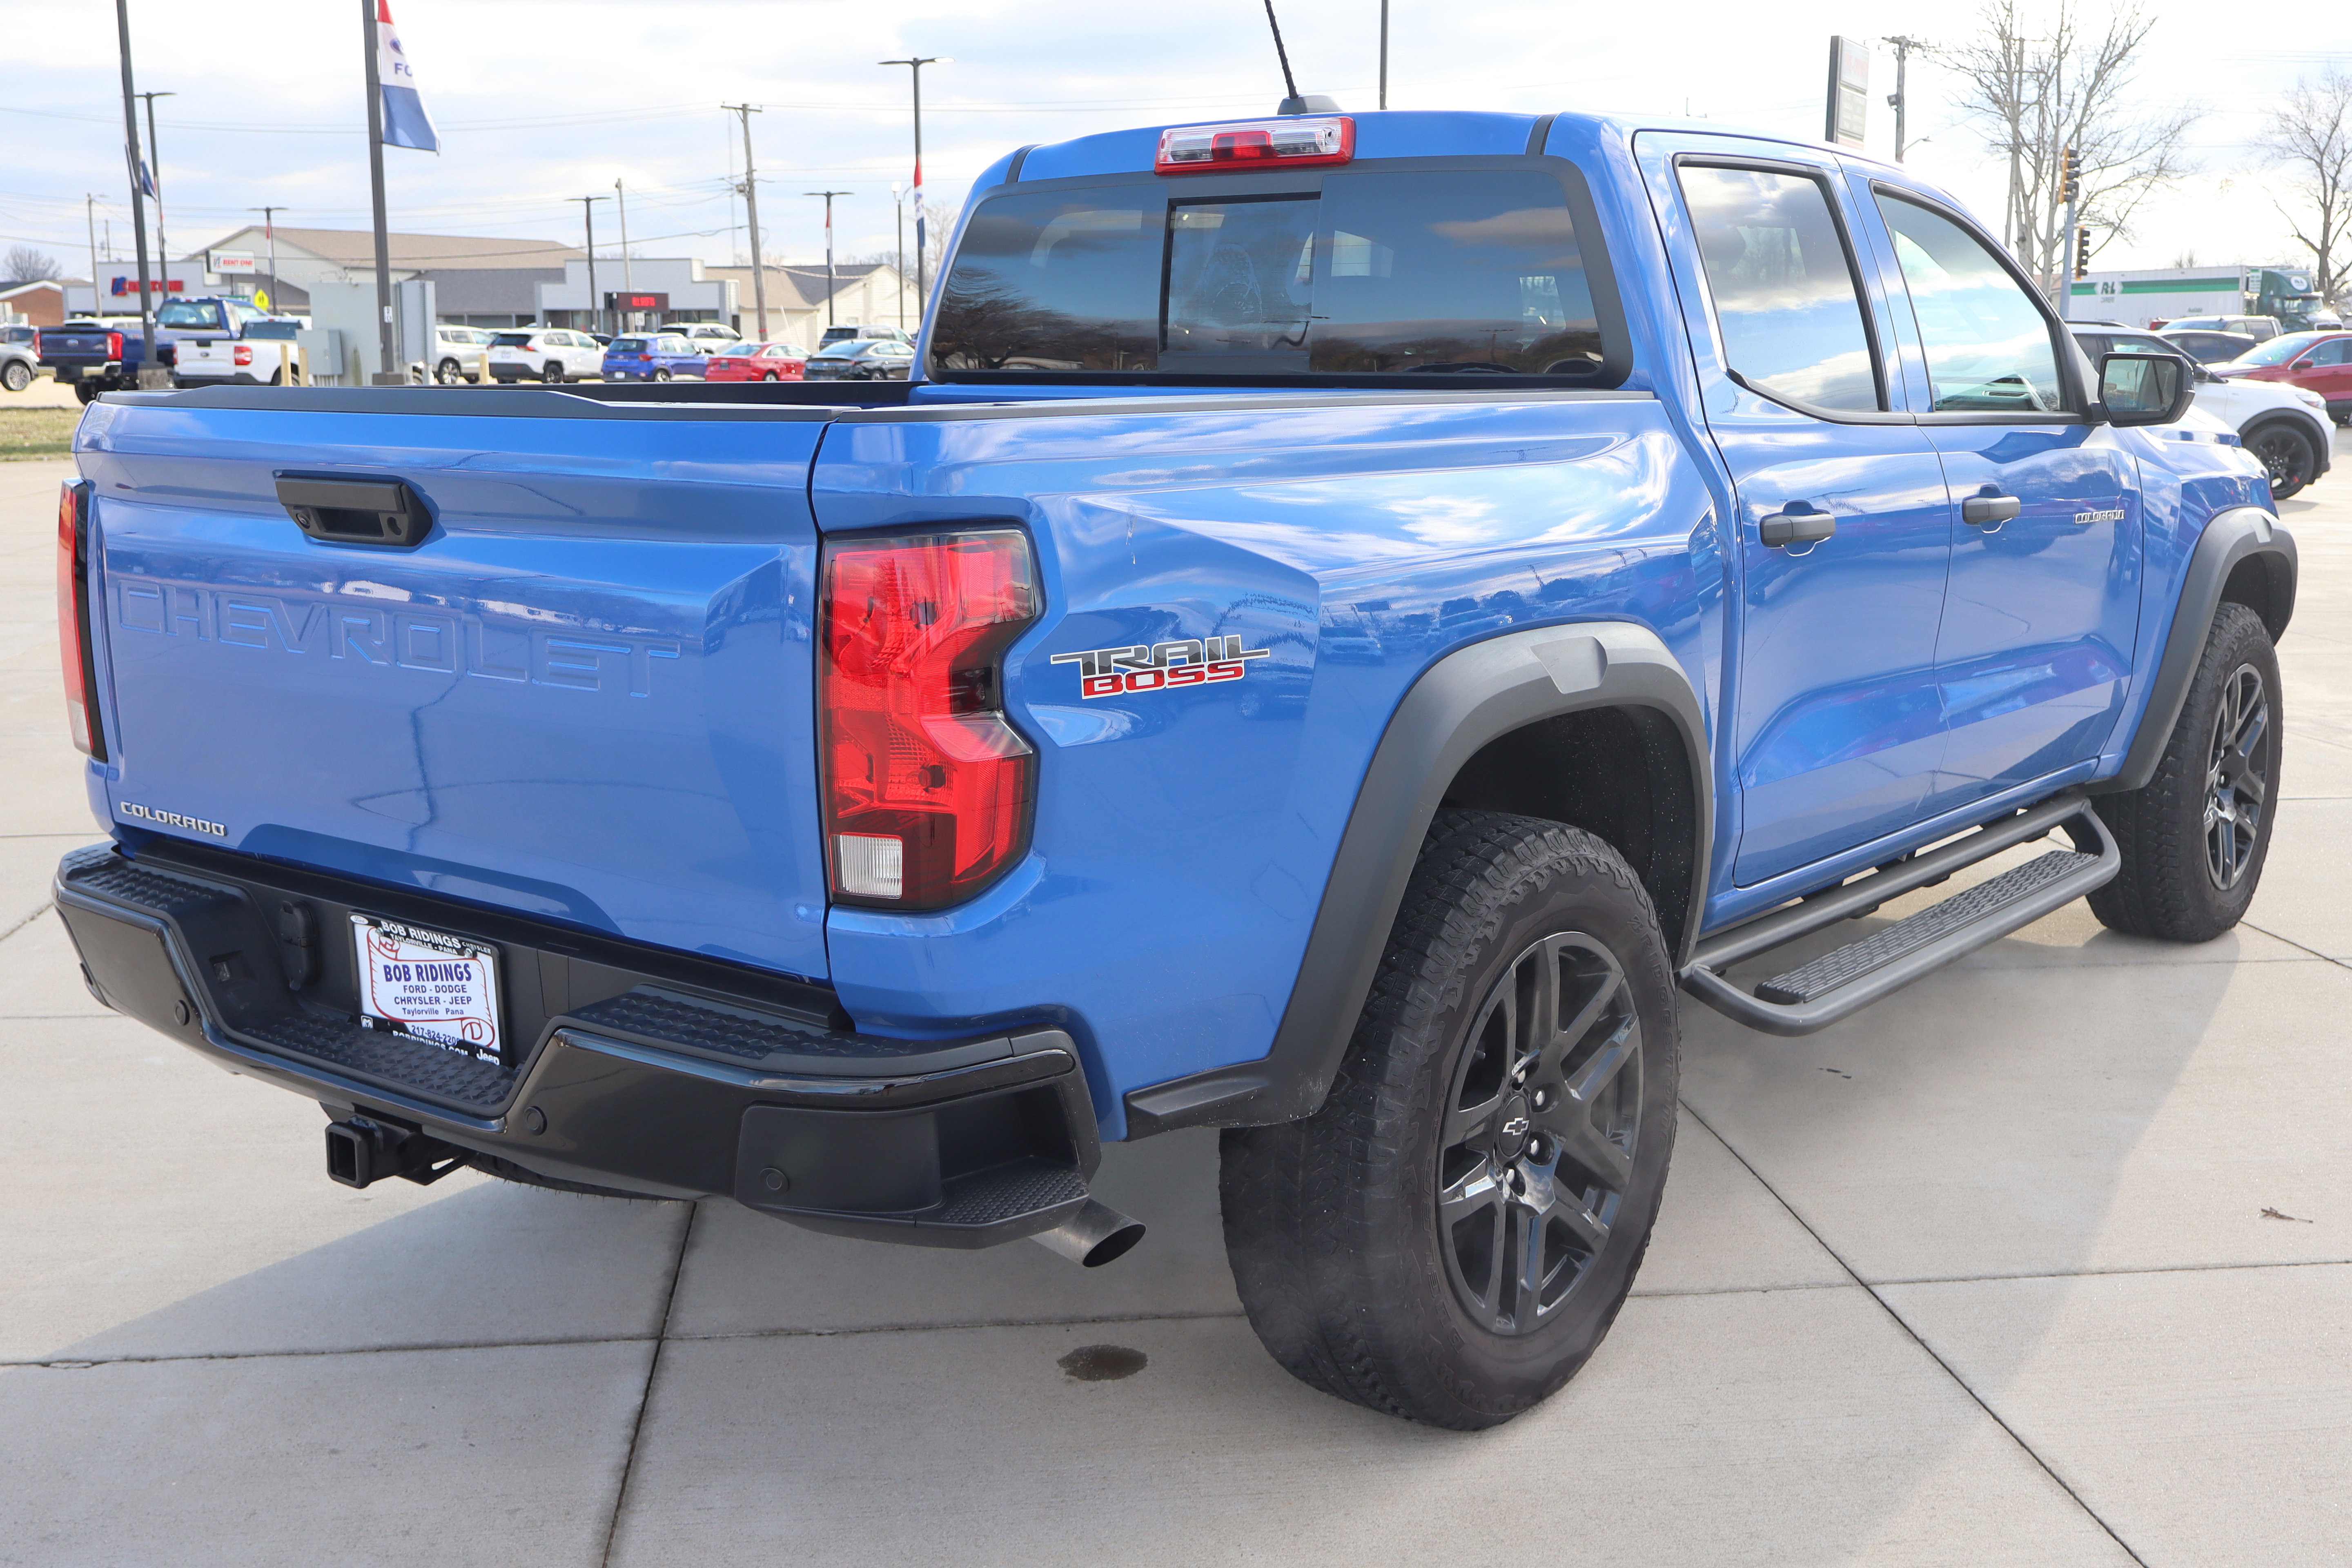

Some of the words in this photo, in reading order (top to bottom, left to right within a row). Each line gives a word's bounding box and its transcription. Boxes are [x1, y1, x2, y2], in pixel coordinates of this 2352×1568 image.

[2074, 509, 2125, 524] COLORADO
[118, 578, 681, 698] CHEVROLET
[1050, 634, 1270, 678] TRAIL
[1082, 659, 1245, 699] BOSS
[120, 801, 227, 837] COLORADO
[381, 920, 407, 936] BOB
[408, 927, 461, 949] RIDINGS
[390, 933, 433, 949] TAYLORVILLE
[438, 945, 458, 955] PANA
[462, 941, 491, 954] CHRYSLER
[383, 964, 412, 982] BOB
[415, 963, 472, 982] RIDINGS
[394, 996, 441, 1005] CHRYSLER
[449, 996, 472, 1005] JEEP
[403, 985, 427, 993] FORD
[435, 984, 468, 993] DODGE
[402, 1008, 439, 1016] Taylorville
[393, 1030, 468, 1056] BOBRIDINGSCOM
[1626, 915, 1674, 1156] BRIDGESTONE
[476, 1049, 500, 1066] Jeep
[1422, 1157, 1467, 1353] DUELER
